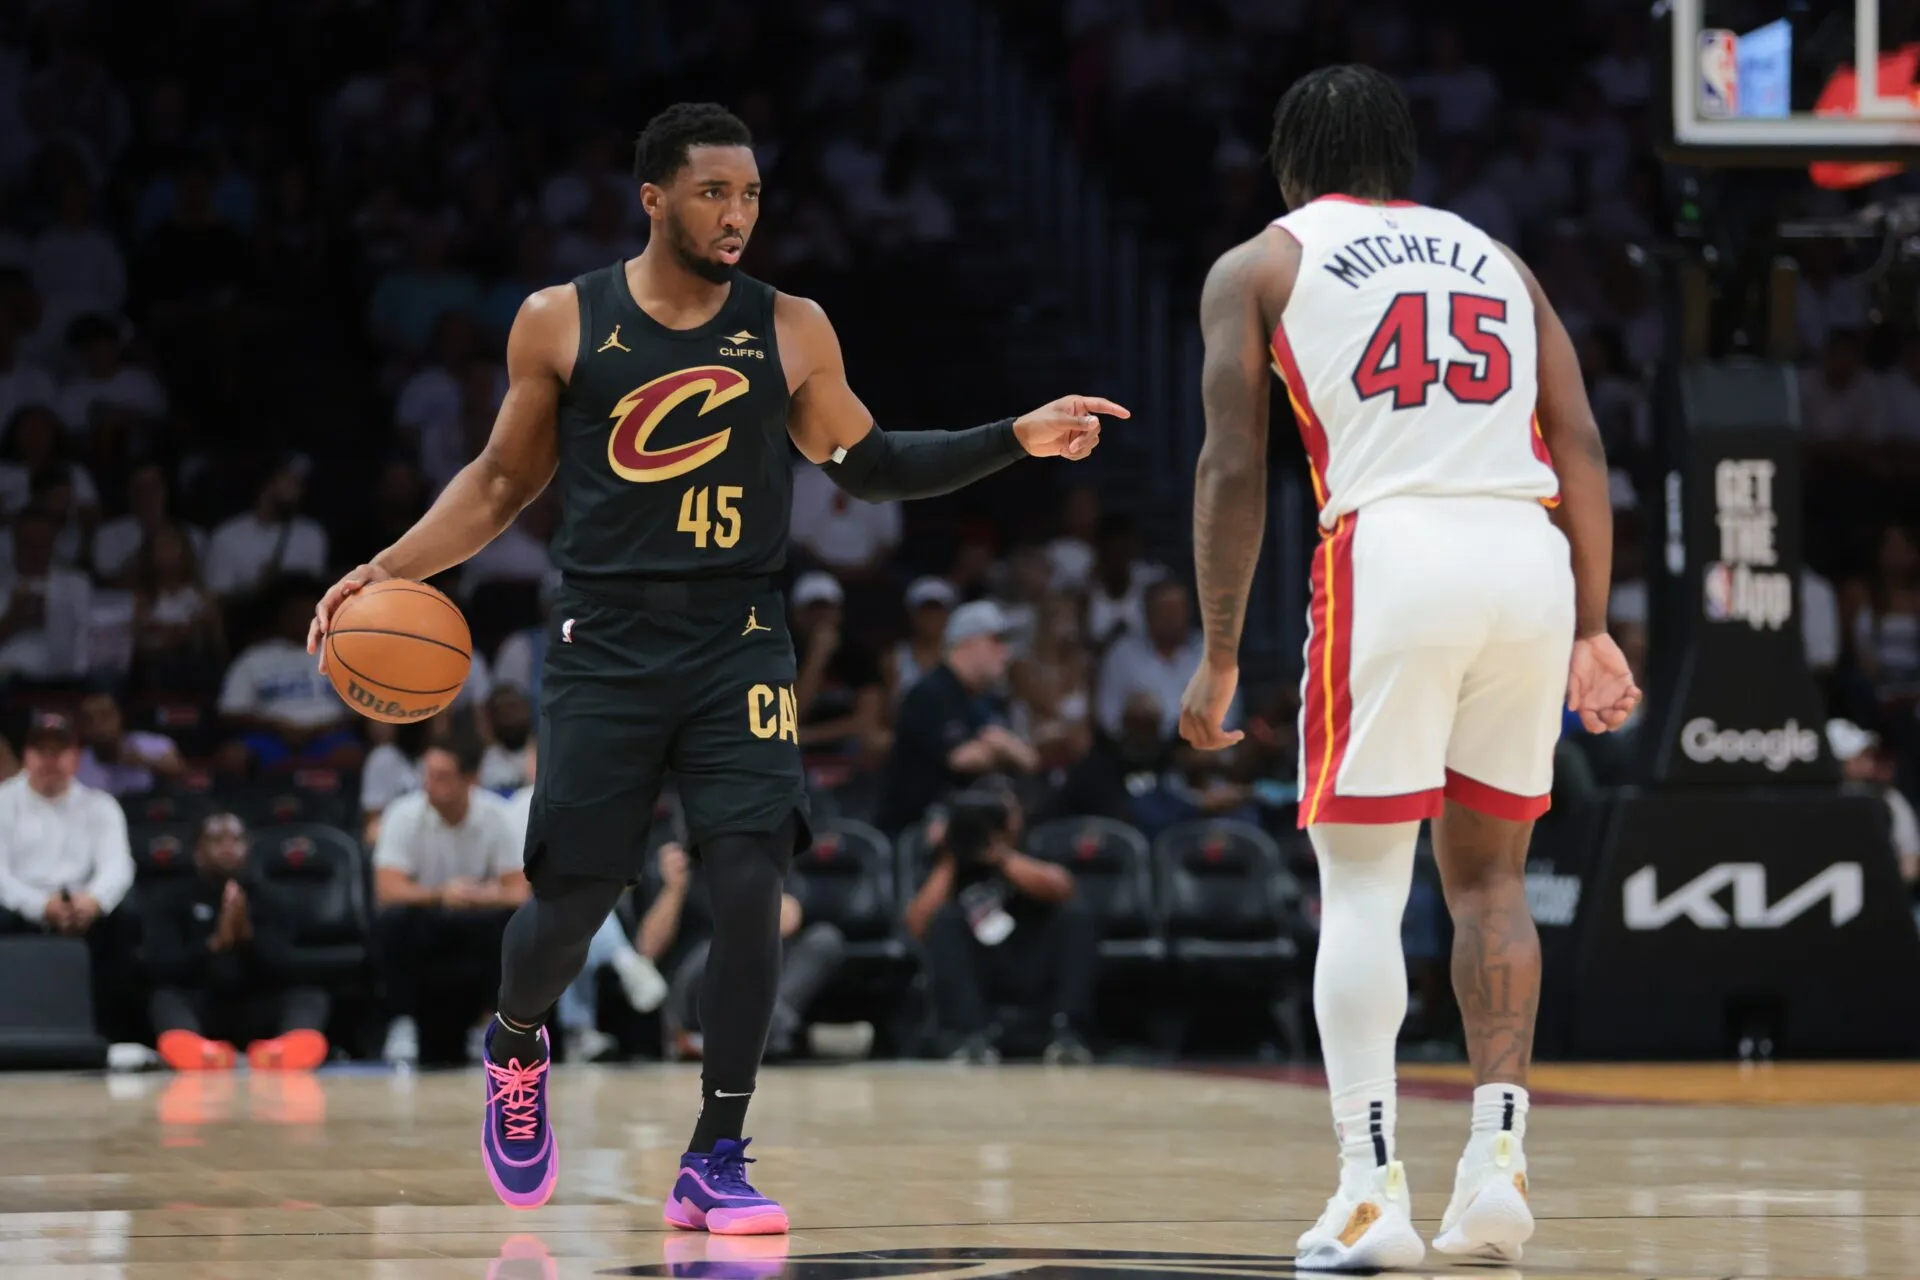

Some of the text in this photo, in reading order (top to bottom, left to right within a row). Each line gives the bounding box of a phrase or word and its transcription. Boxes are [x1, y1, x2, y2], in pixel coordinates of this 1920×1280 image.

[1323, 234, 1488, 289] MITCHELL
[719, 347, 764, 360] CLIFFS
[1351, 291, 1512, 411] 45
[607, 364, 750, 483] C
[676, 485, 744, 548] 45
[348, 679, 440, 718] Wilson
[1680, 716, 1819, 773] Google
[1622, 861, 1864, 931] KIA
